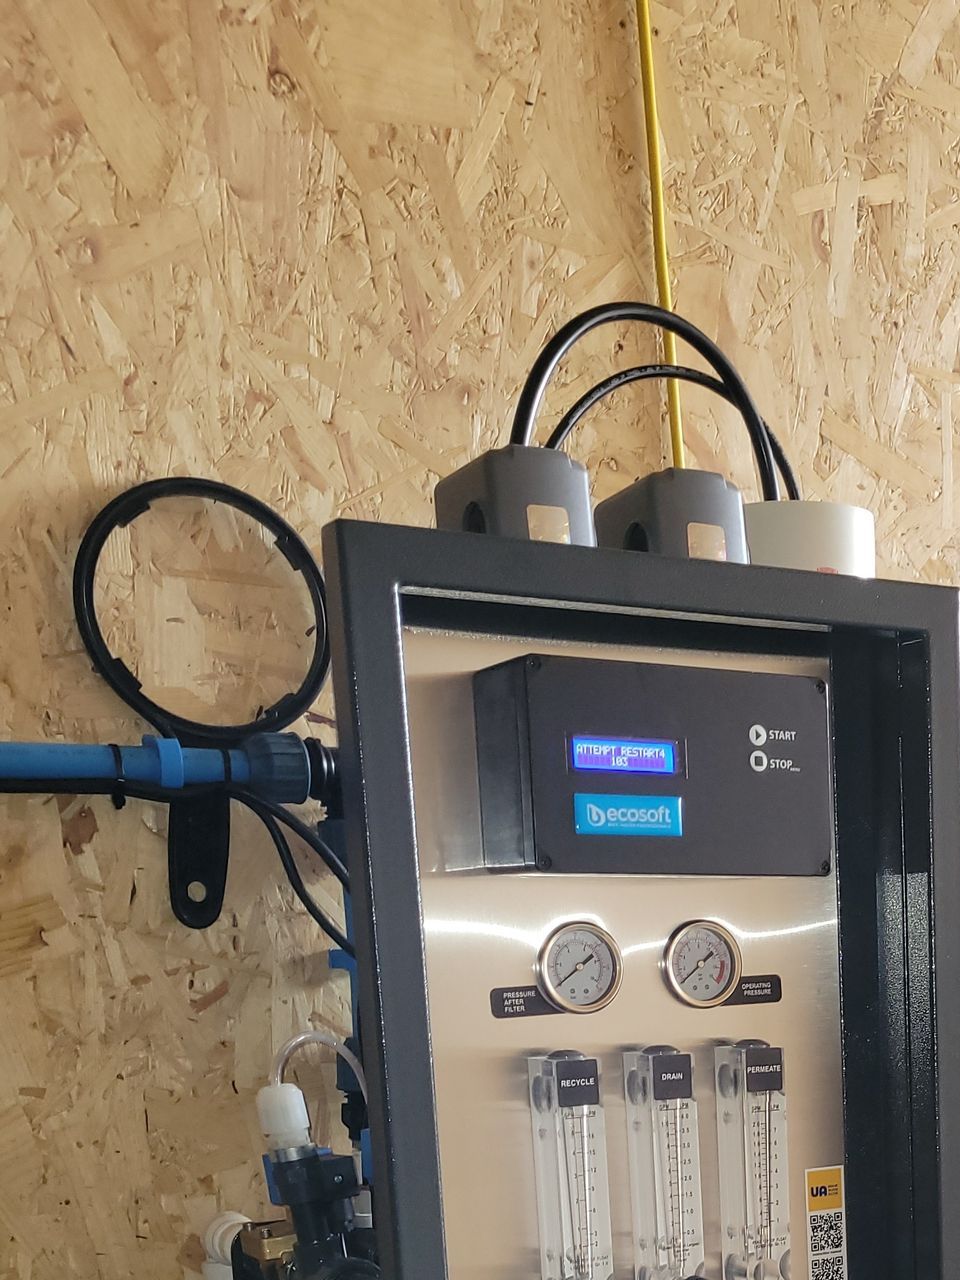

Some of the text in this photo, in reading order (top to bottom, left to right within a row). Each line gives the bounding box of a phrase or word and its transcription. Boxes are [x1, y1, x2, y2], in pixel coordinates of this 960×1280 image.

[769, 730, 796, 741] START
[576, 743, 616, 756] ATTEMPT
[770, 759, 793, 769] STOP
[606, 805, 672, 823] ecosoft
[741, 981, 772, 990] OPERATING
[503, 990, 536, 999] PRESSURE
[743, 988, 772, 997] PRESSURE
[503, 999, 525, 1007] AFTER
[504, 1005, 525, 1013] FILTER
[747, 1064, 781, 1074] PERMEATE
[661, 1072, 683, 1080] DRAIN
[560, 1077, 595, 1088] RECYCLE
[811, 1185, 827, 1197] UA
